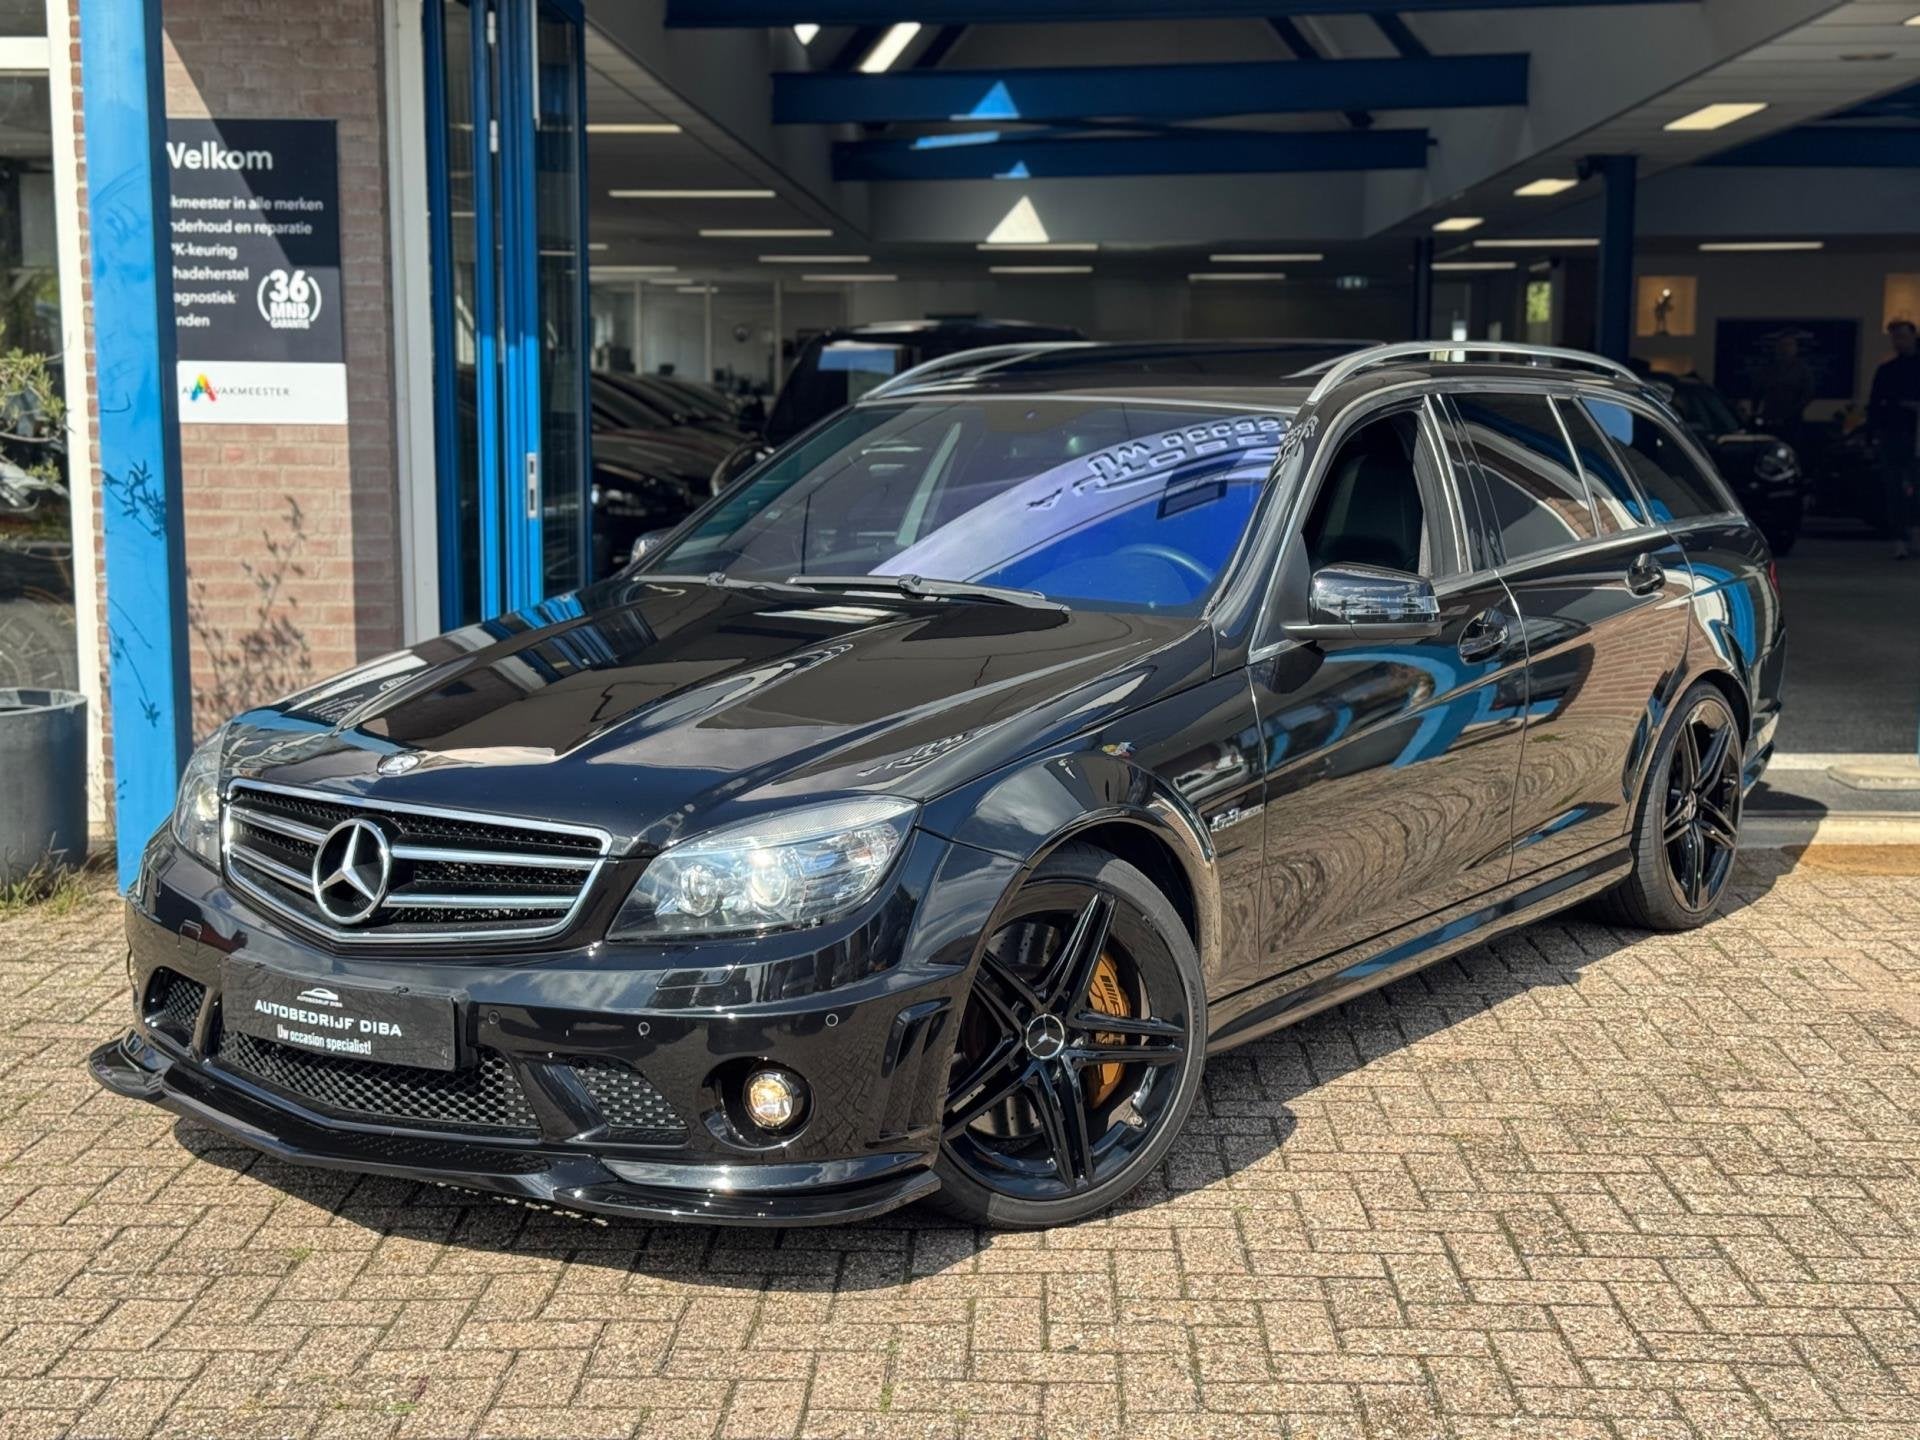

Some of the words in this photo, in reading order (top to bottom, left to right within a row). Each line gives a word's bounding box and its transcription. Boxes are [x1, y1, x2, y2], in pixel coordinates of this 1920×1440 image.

[171, 195, 231, 210] kmeester
[233, 196, 246, 210] in
[248, 196, 272, 210] alle
[274, 197, 324, 211] merken
[171, 219, 232, 233] nderhoud
[234, 222, 251, 233] en
[254, 220, 312, 236] reparatie
[171, 243, 238, 260] K-keuring
[173, 266, 249, 281] hadeherstel
[269, 269, 310, 302] 36
[174, 291, 236, 306] agnostiek
[270, 302, 310, 319] MND
[176, 314, 210, 327] nden
[254, 999, 355, 1031] AUTOBEDRIJF
[359, 1019, 402, 1037] DIBA
[277, 1023, 289, 1040] Uw
[289, 1029, 325, 1048] occasion
[325, 1036, 372, 1055] specialist!
